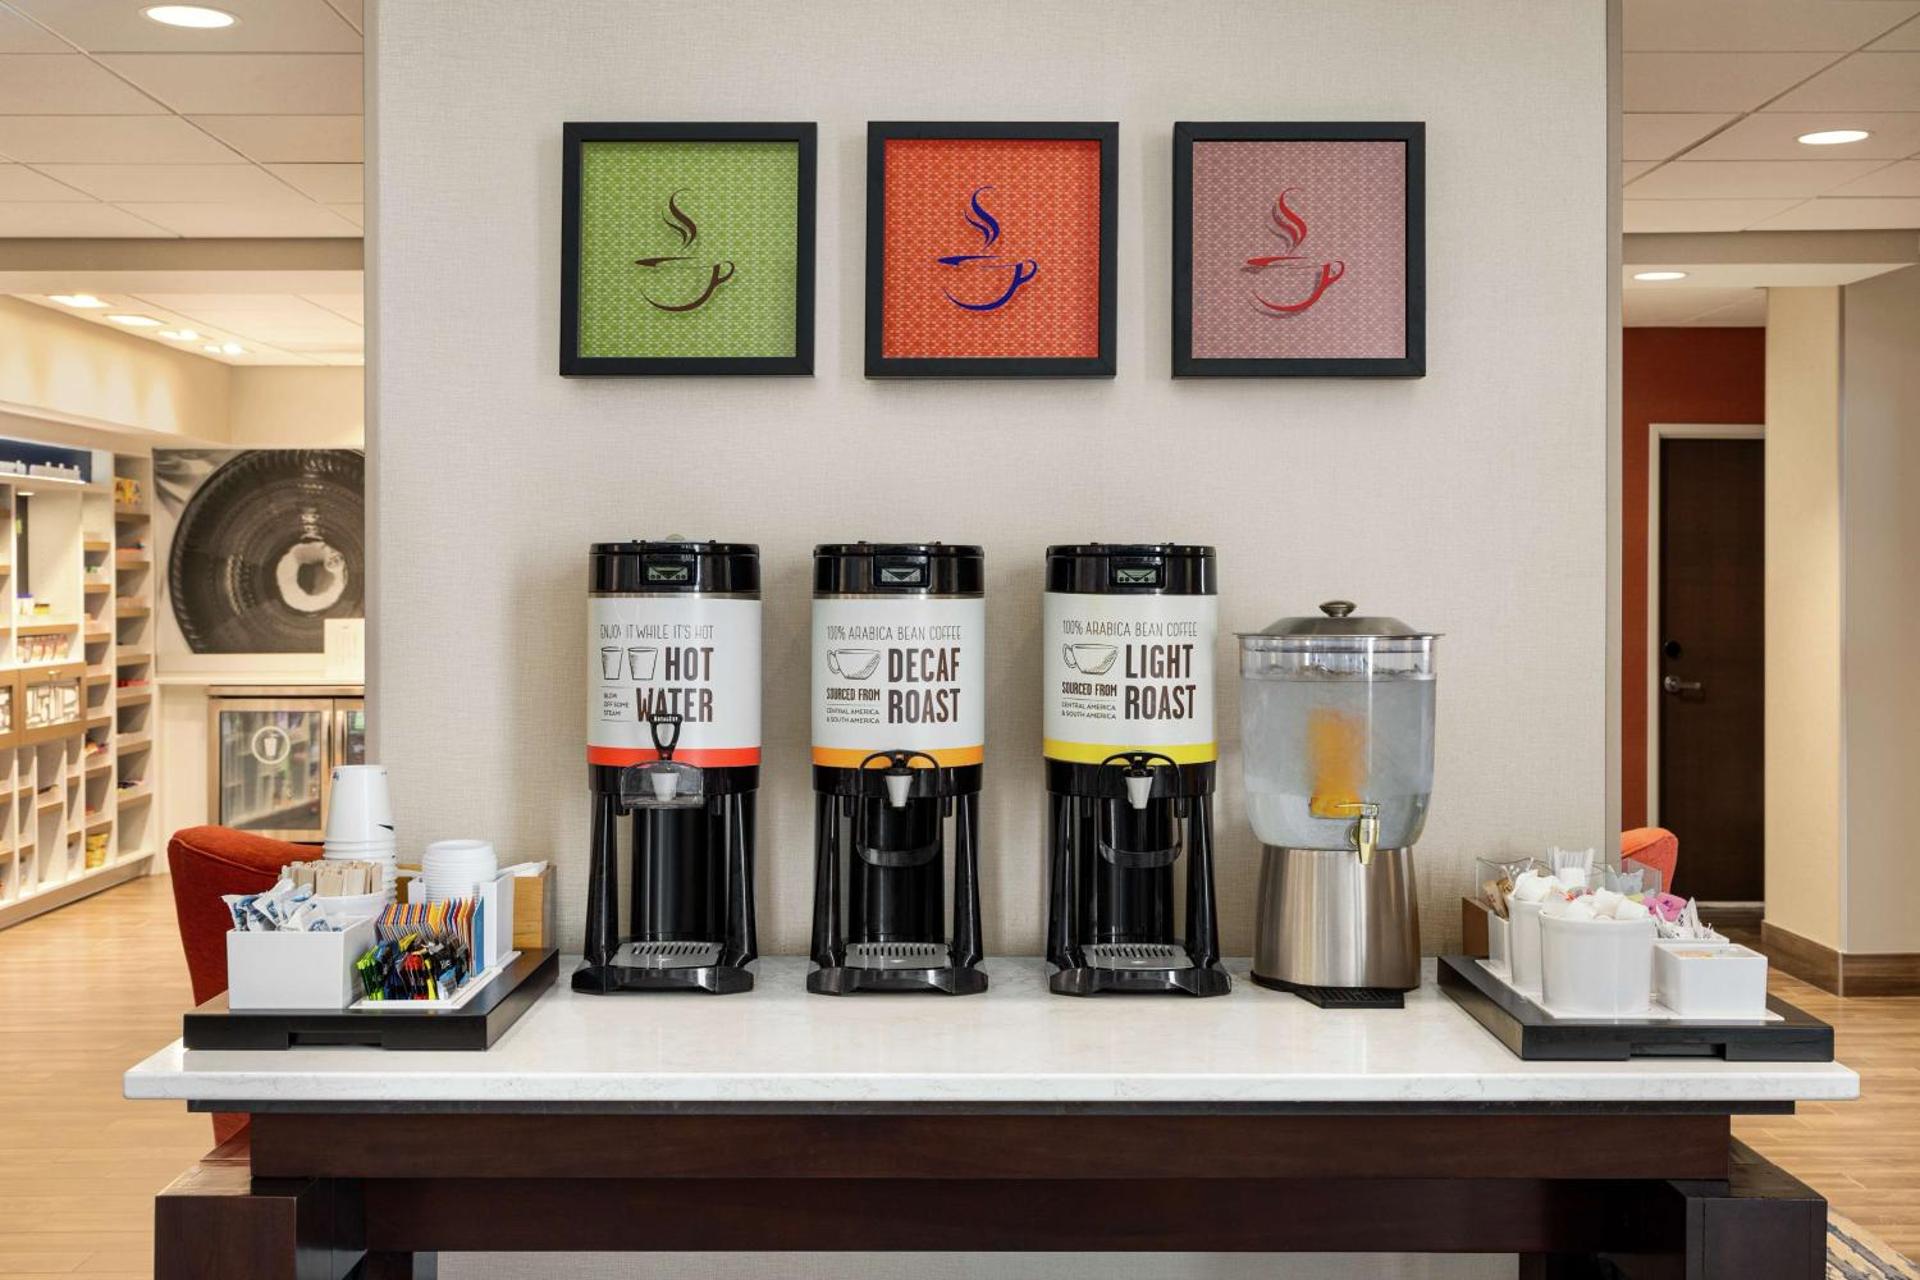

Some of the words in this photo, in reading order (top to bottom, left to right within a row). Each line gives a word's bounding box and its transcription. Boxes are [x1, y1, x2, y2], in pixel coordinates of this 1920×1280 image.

[600, 624, 621, 640] ENJOY
[626, 625, 635, 639] IT
[636, 624, 669, 639] WHILE
[673, 624, 691, 639] IT'S
[695, 624, 714, 639] HOT
[826, 625, 845, 640] 100%
[848, 625, 893, 640] ARABICA
[897, 626, 925, 640] BEAN
[929, 626, 961, 640] COFFEE
[1062, 619, 1083, 635] 100%
[1085, 621, 1131, 637] ARABICA
[1136, 621, 1164, 637] BEAN
[1167, 621, 1198, 637] COFFEE
[665, 646, 715, 681] HOT
[887, 647, 961, 683] DECAF
[1125, 644, 1194, 679] LIGHT
[826, 687, 856, 701] SOURCED
[858, 688, 880, 701] FROM
[1062, 681, 1093, 696] SOURCED
[1095, 683, 1117, 697] FROM
[635, 687, 713, 723] WATER
[887, 688, 961, 724] ROAST
[1062, 701, 1086, 709] CENTRAL
[1086, 703, 1117, 711] AMERICA
[1124, 684, 1197, 720] ROAST
[1086, 712, 1117, 720] AMERICA
